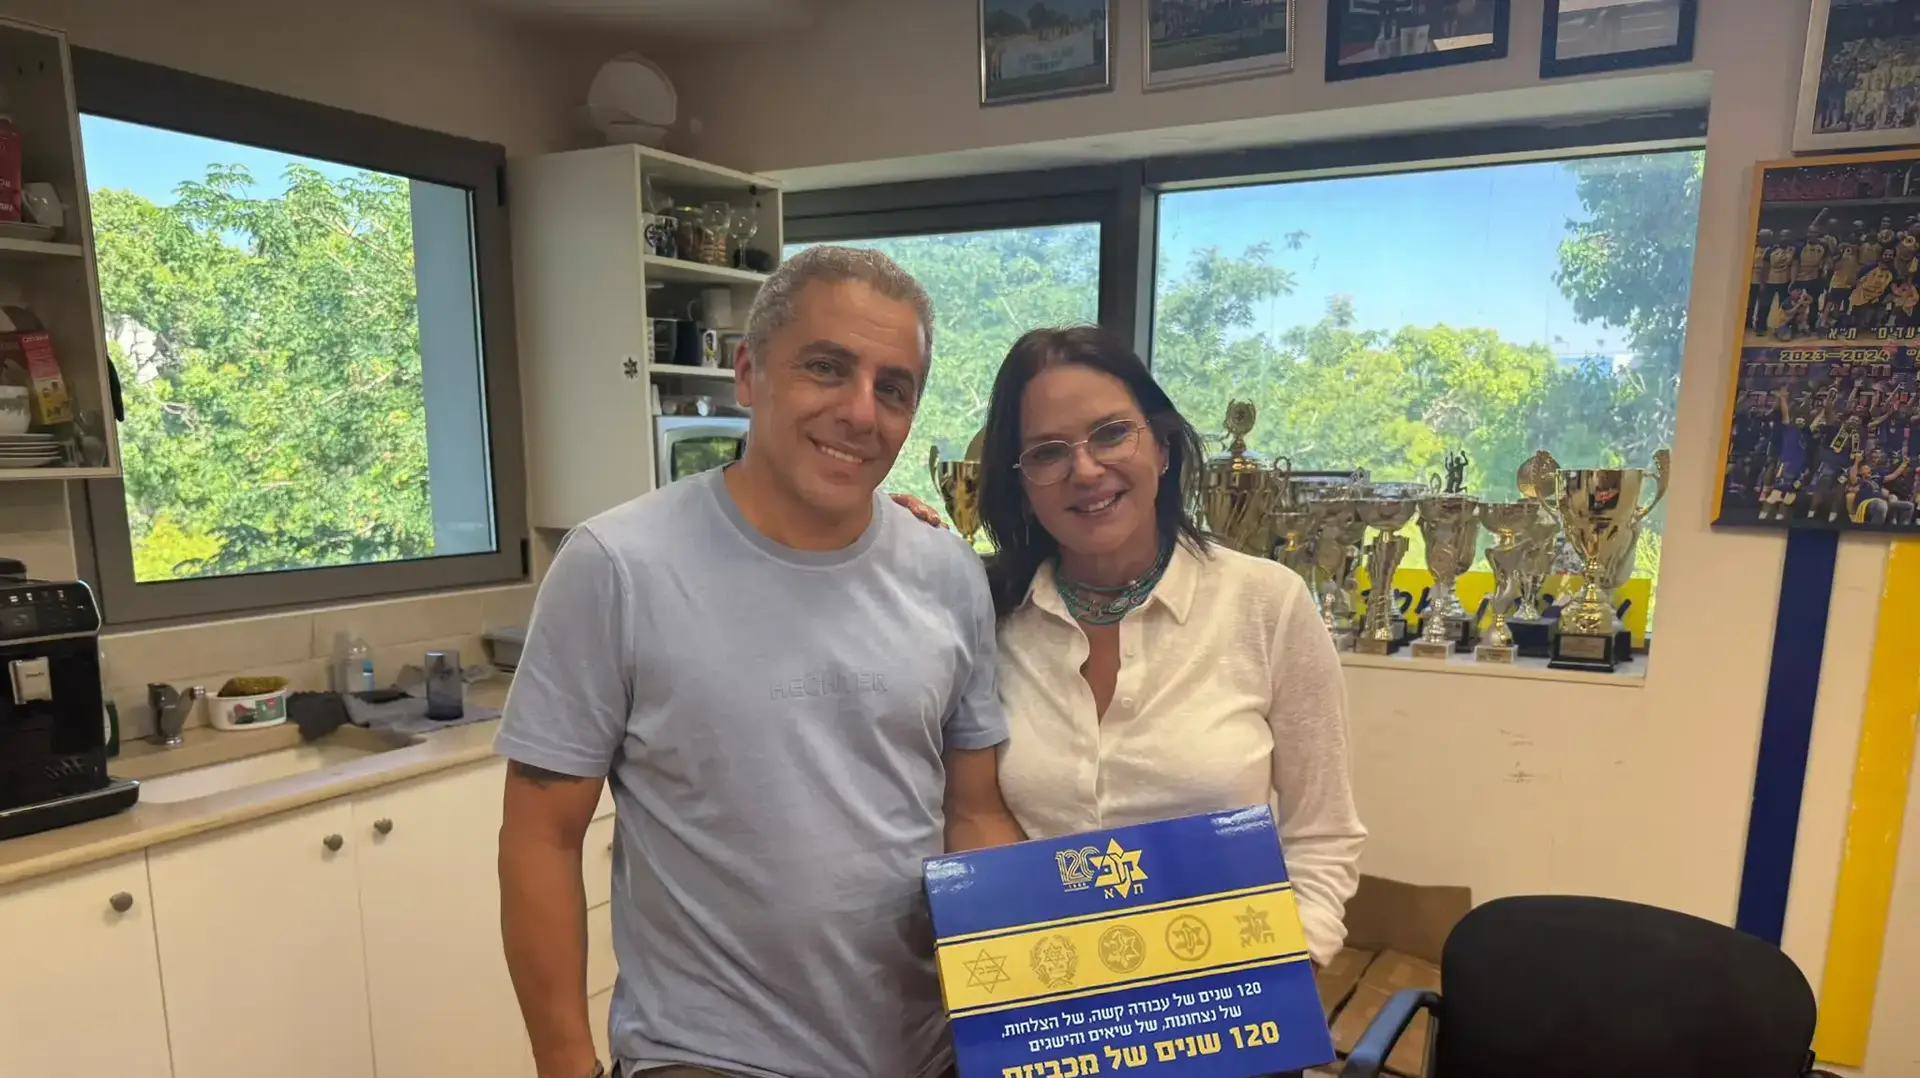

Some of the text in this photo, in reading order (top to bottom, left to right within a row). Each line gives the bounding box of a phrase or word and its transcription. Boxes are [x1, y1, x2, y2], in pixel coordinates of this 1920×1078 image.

[1871, 327, 1920, 339] עדים"
[1002, 981, 1262, 1039] 120 שנים של עבודה קשה, של הצלחות,
[1028, 1005, 1242, 1053] של נצחונות, של שיאים והישגים
[1229, 1021, 1280, 1049] 120
[1103, 1045, 1148, 1070] של
[1153, 1032, 1222, 1062] שנים
